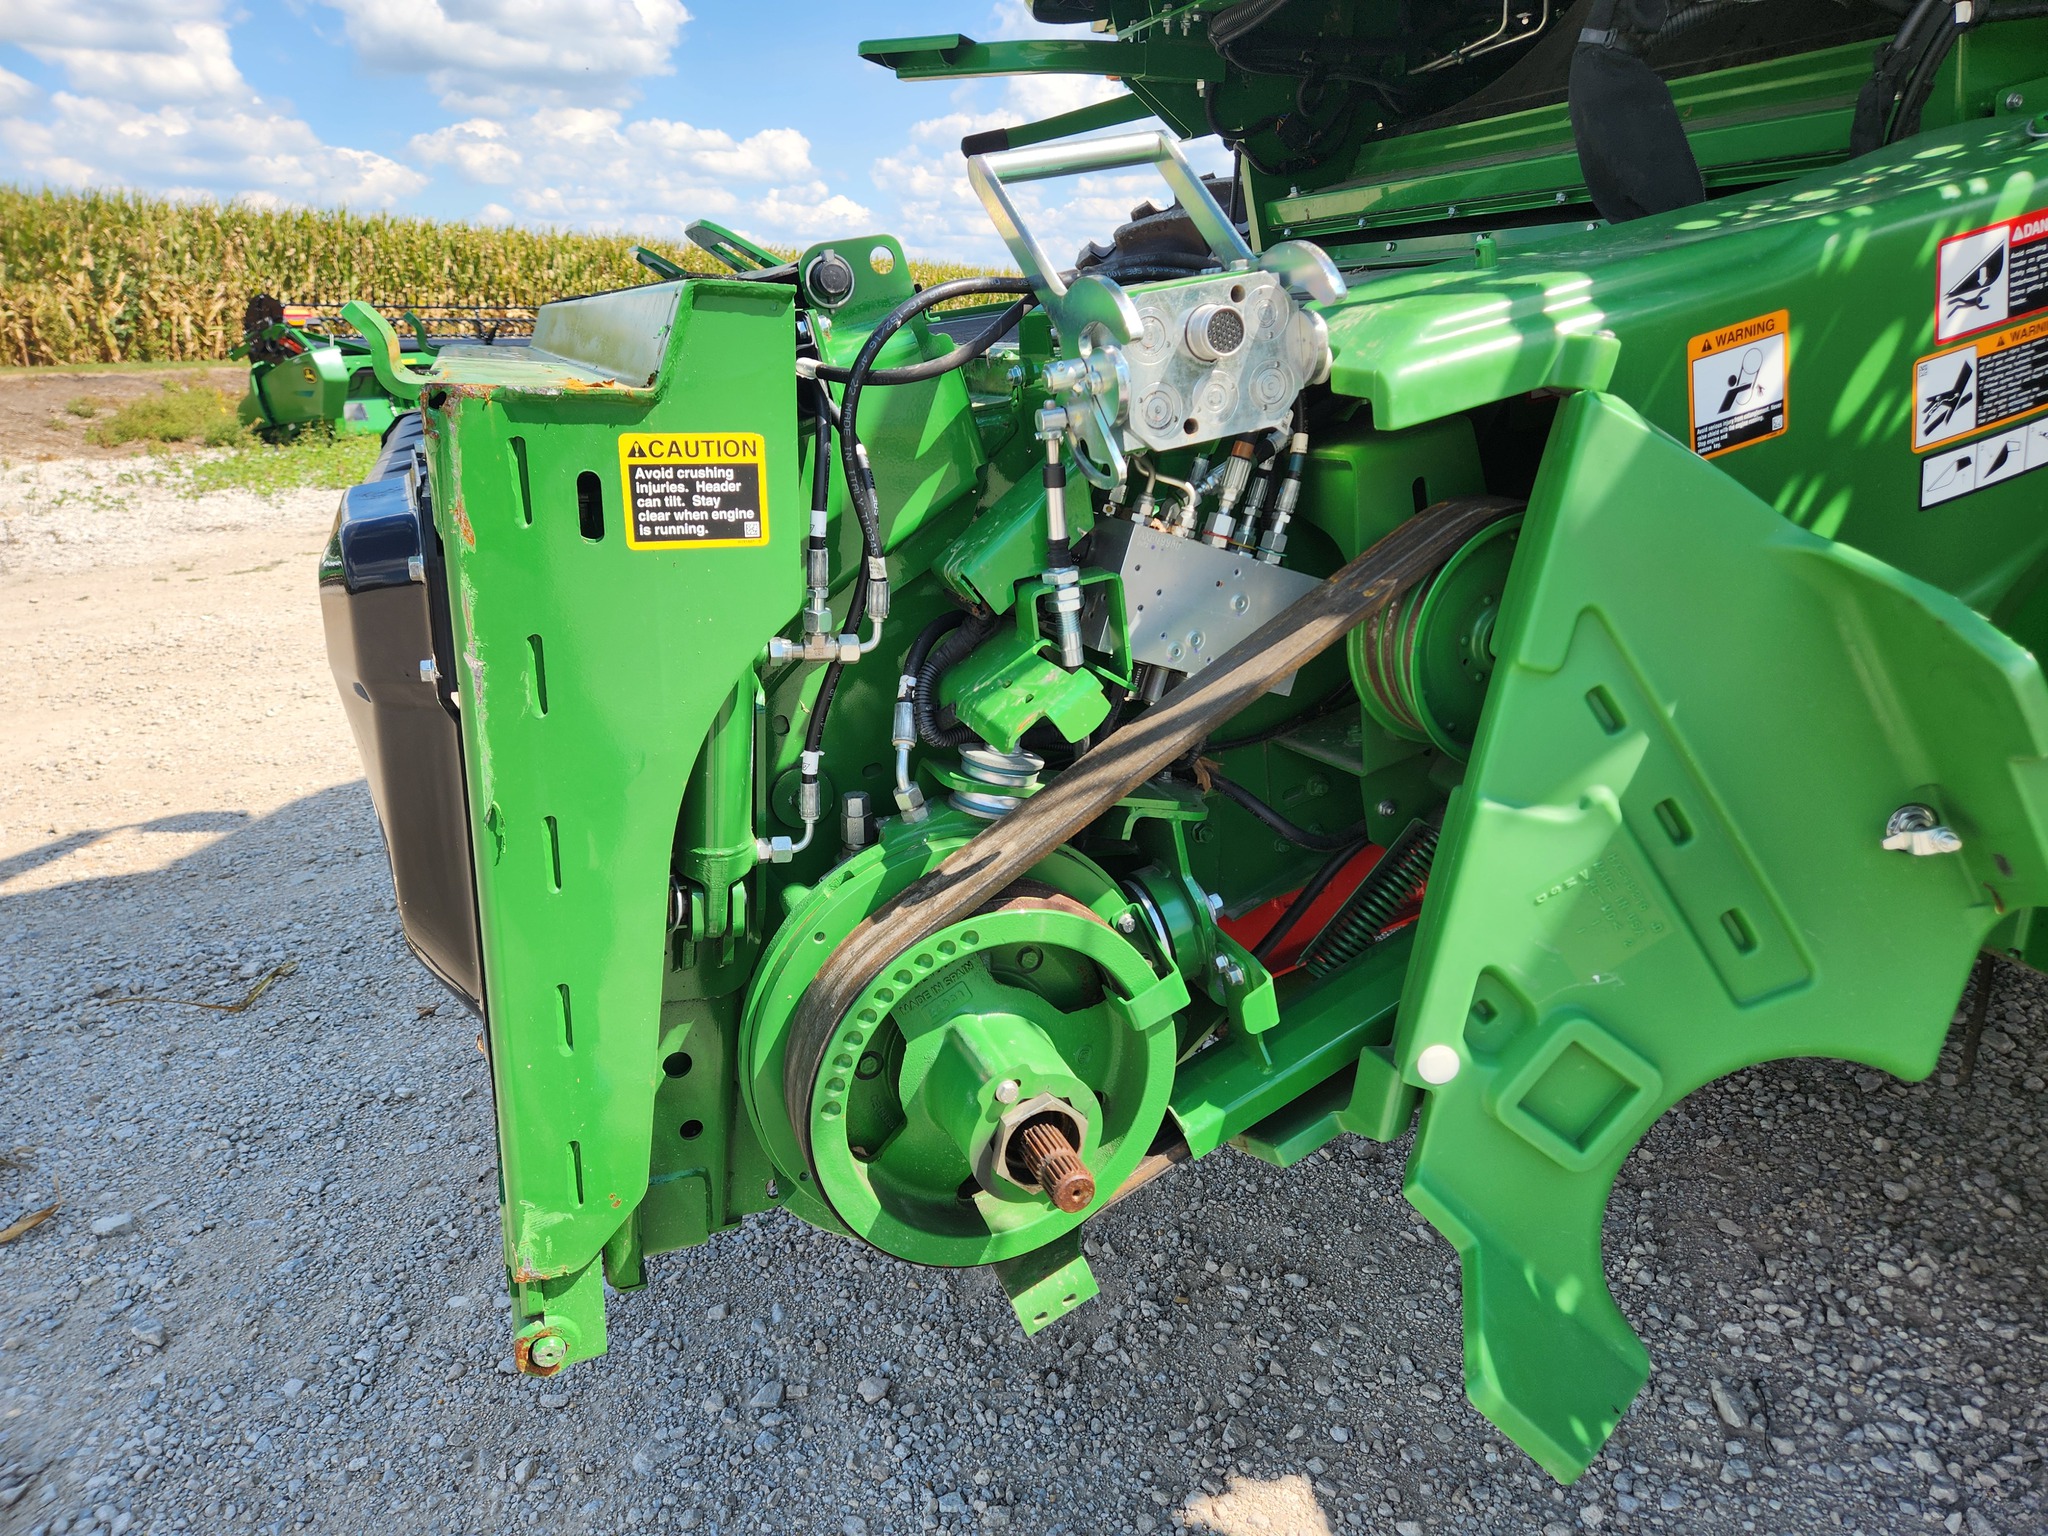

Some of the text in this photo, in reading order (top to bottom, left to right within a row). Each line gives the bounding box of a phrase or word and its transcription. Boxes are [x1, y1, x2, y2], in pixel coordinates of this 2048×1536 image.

[1715, 318, 1775, 347] WARNING
[843, 402, 853, 437] MADE
[648, 439, 757, 458] CAUTION
[844, 446, 853, 461] IN
[635, 466, 734, 480] Avoid crushing
[635, 480, 742, 496] injuries. Header
[848, 470, 865, 507] ITALY
[637, 495, 721, 509] can tilt. Stay
[638, 508, 755, 522] clear when engine
[639, 523, 709, 537] is running.
[1592, 860, 1646, 936] MADE IN USA
[899, 989, 932, 1015] MADE
[930, 981, 944, 994] IN
[943, 960, 975, 986] SPAIN
